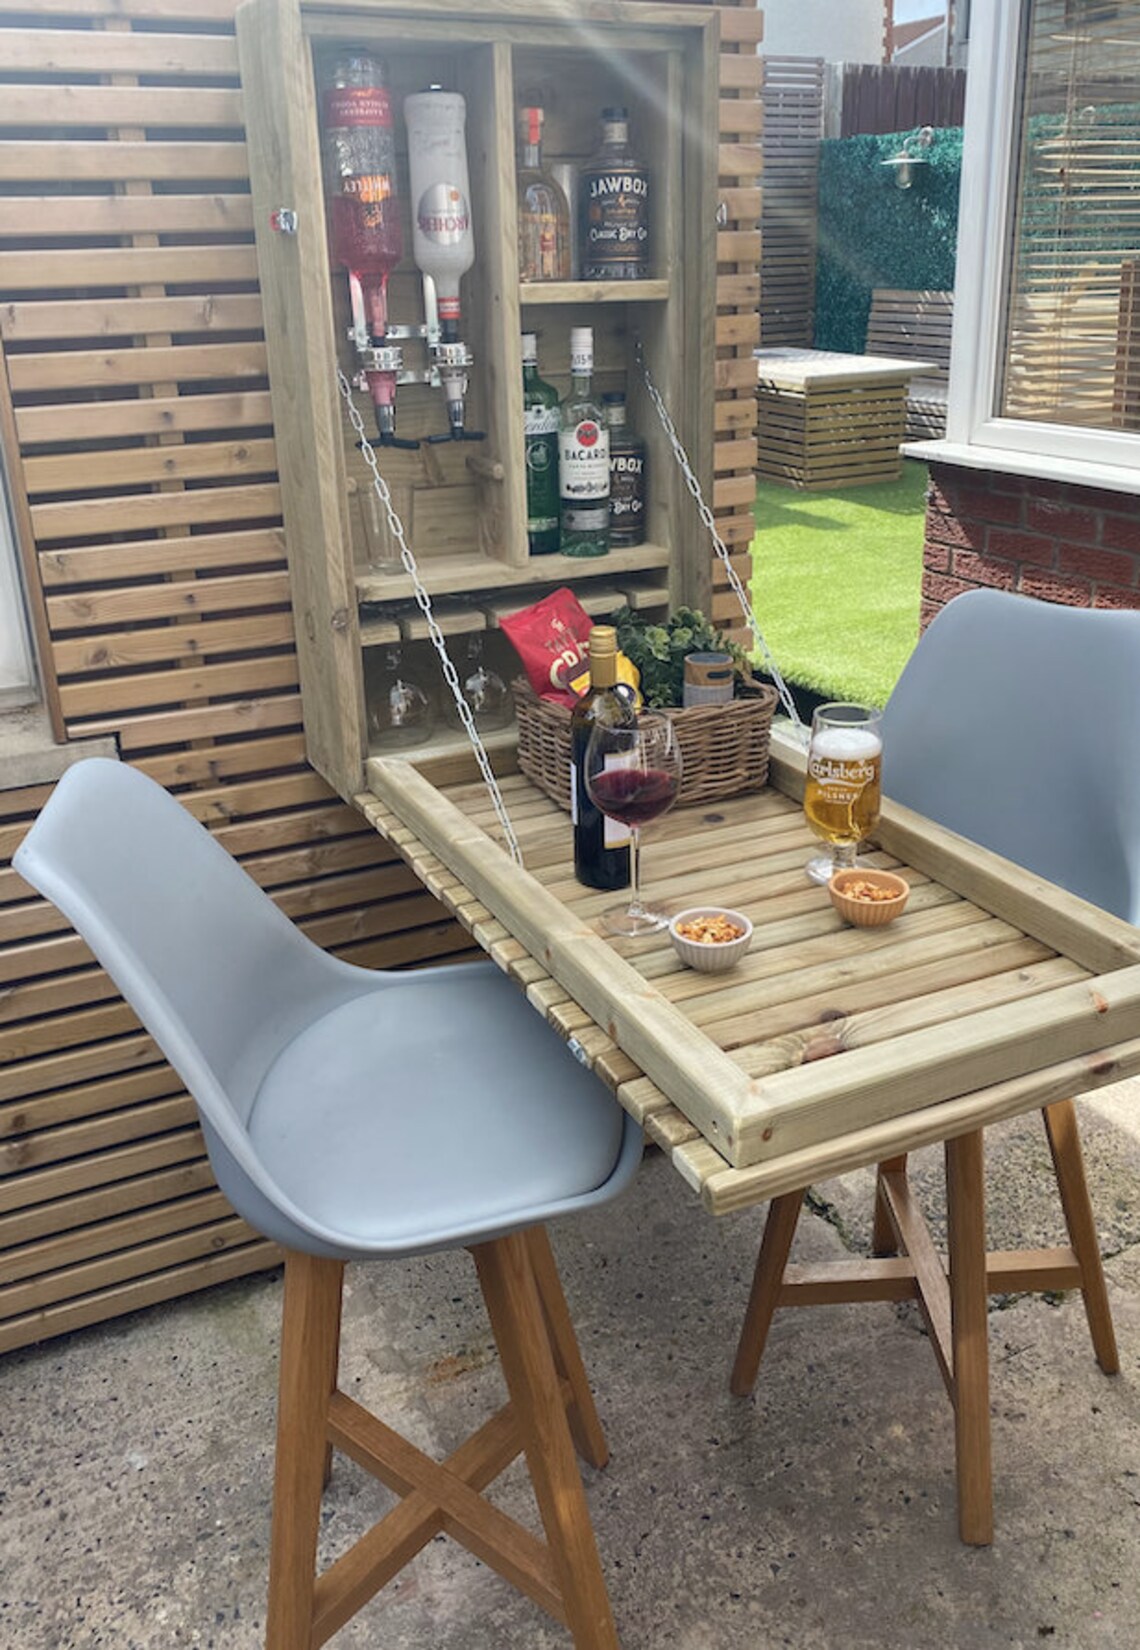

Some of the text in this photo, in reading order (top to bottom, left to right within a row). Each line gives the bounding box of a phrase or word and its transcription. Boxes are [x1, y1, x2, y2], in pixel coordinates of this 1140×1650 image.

[590, 176, 648, 198] JAWBOX
[565, 448, 607, 461] BACARD
[609, 457, 644, 474] BOX
[809, 756, 875, 784] Carlsberg
